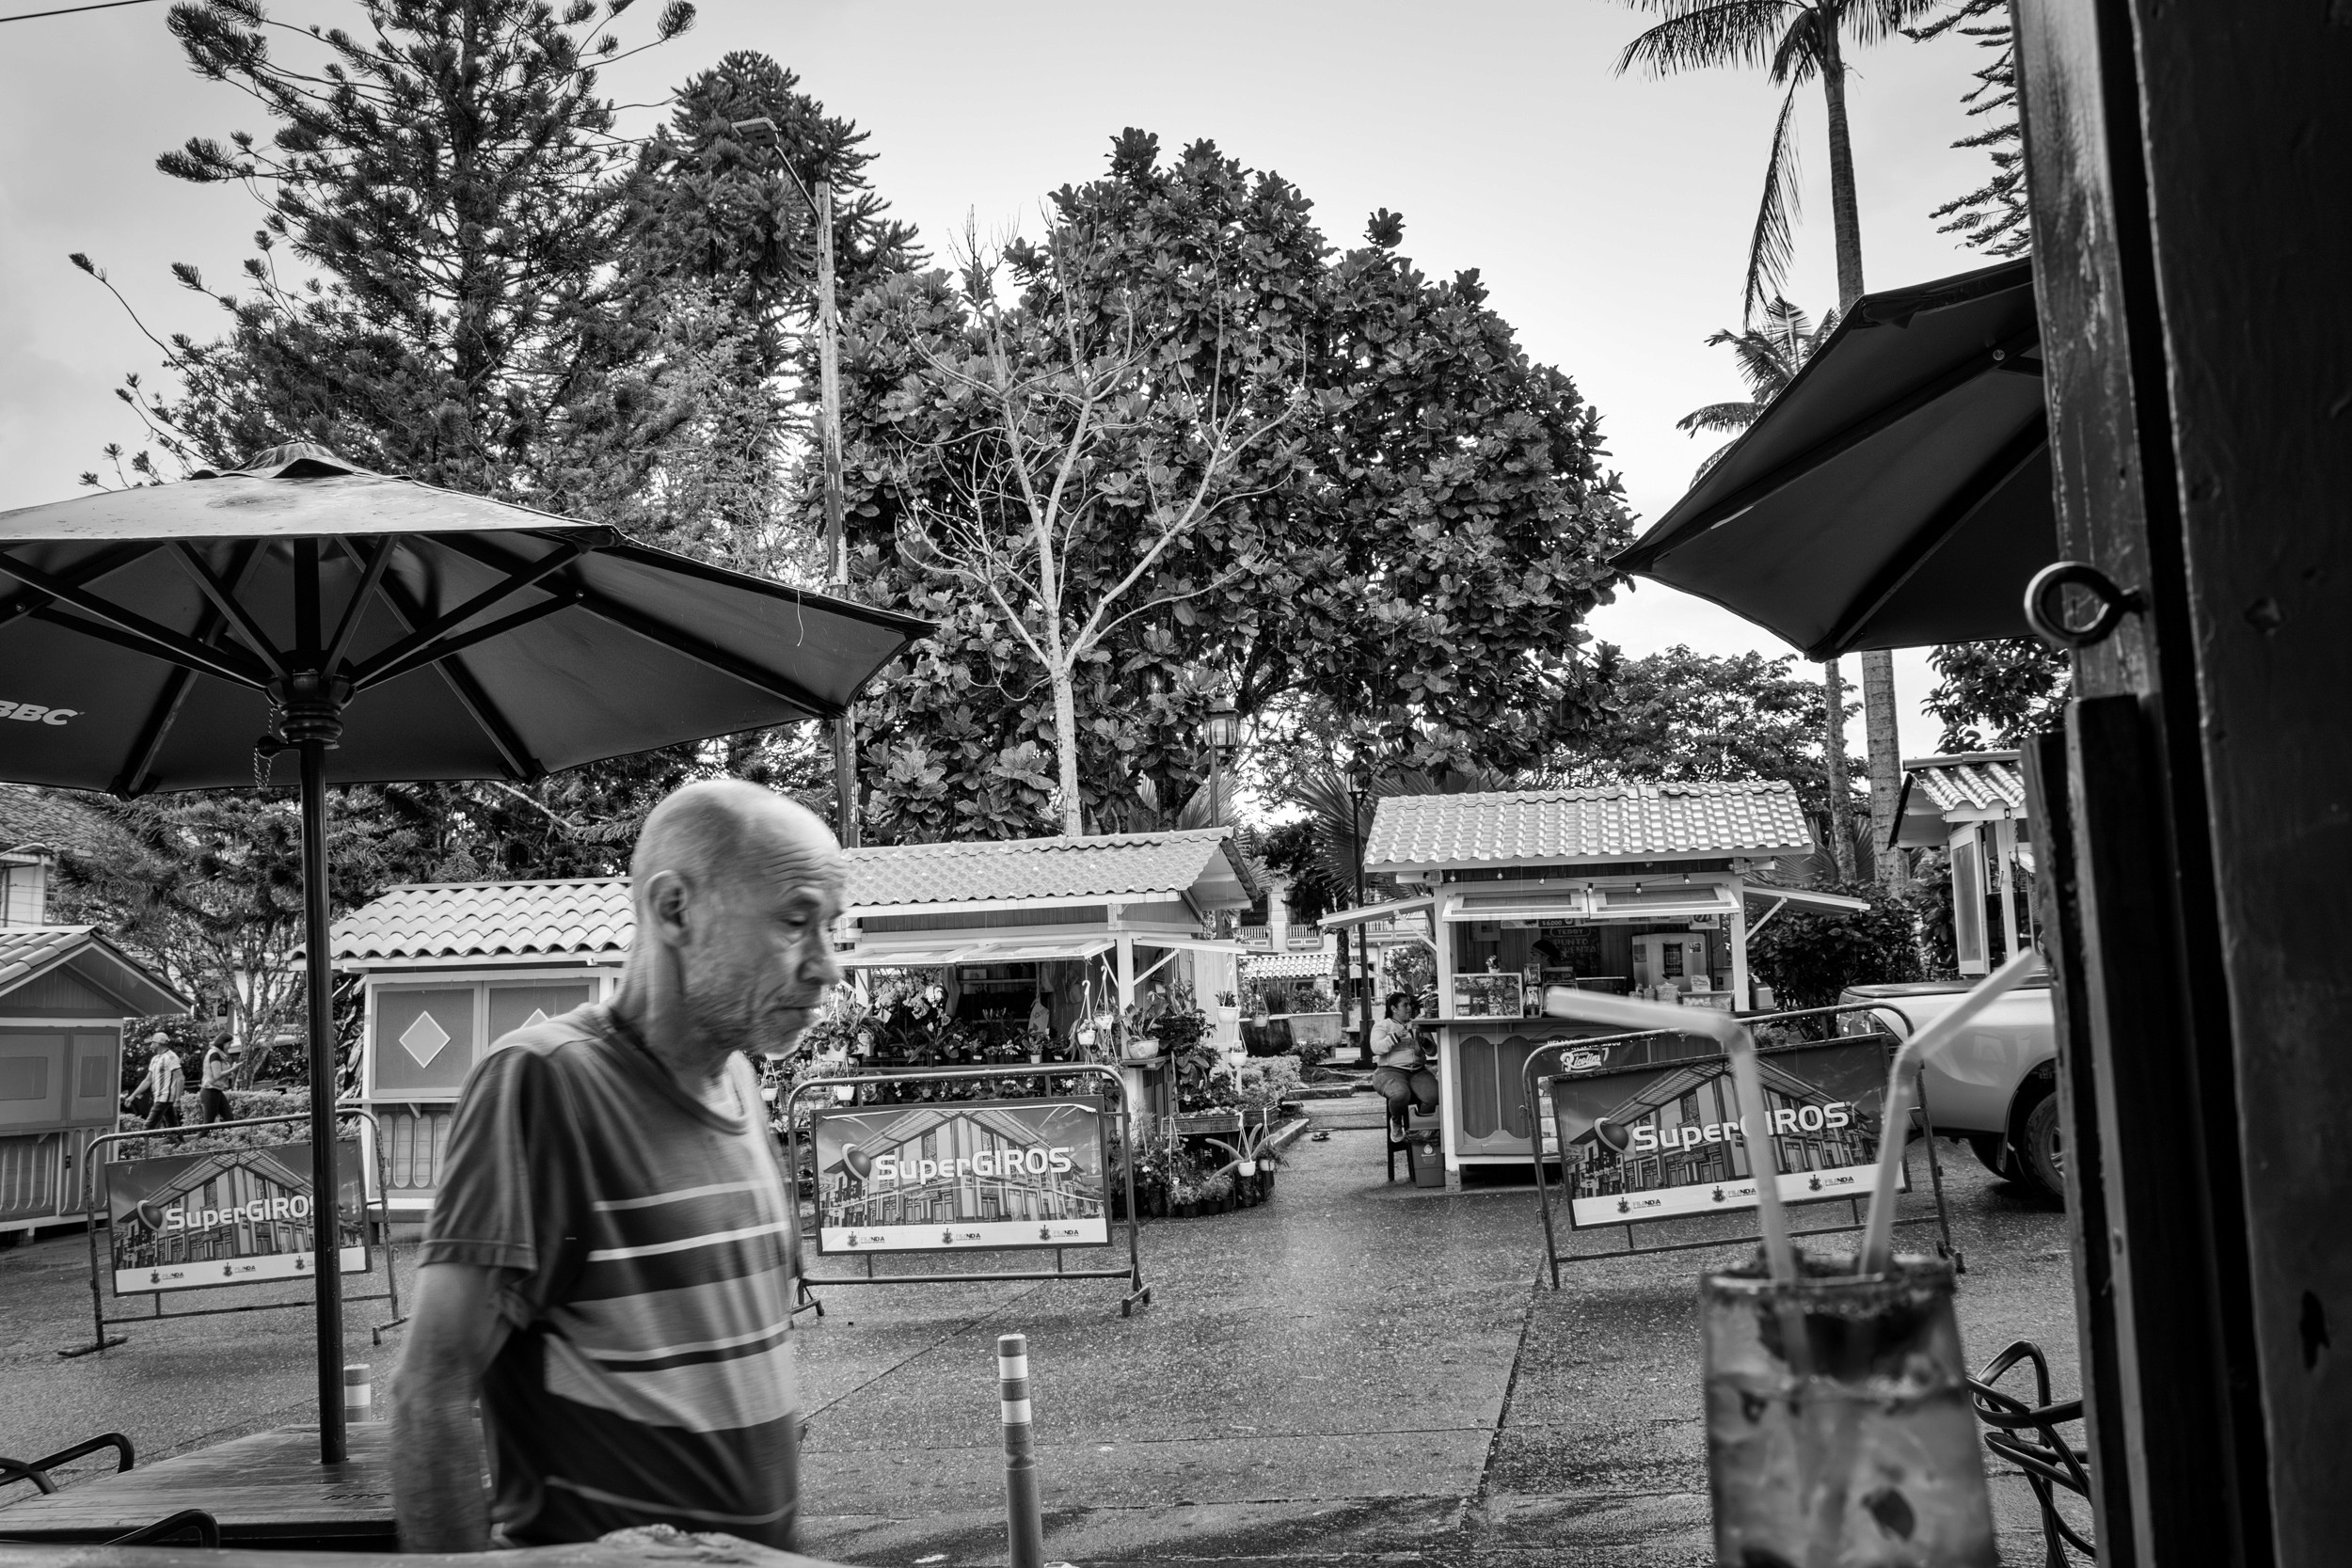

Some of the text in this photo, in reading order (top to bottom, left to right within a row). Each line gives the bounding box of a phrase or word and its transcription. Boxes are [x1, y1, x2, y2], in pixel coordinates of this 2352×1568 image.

[1552, 938, 1589, 946] PUNTO
[875, 1147, 1073, 1185] SuperGIROS
[166, 1195, 313, 1231] SuperGIRO
